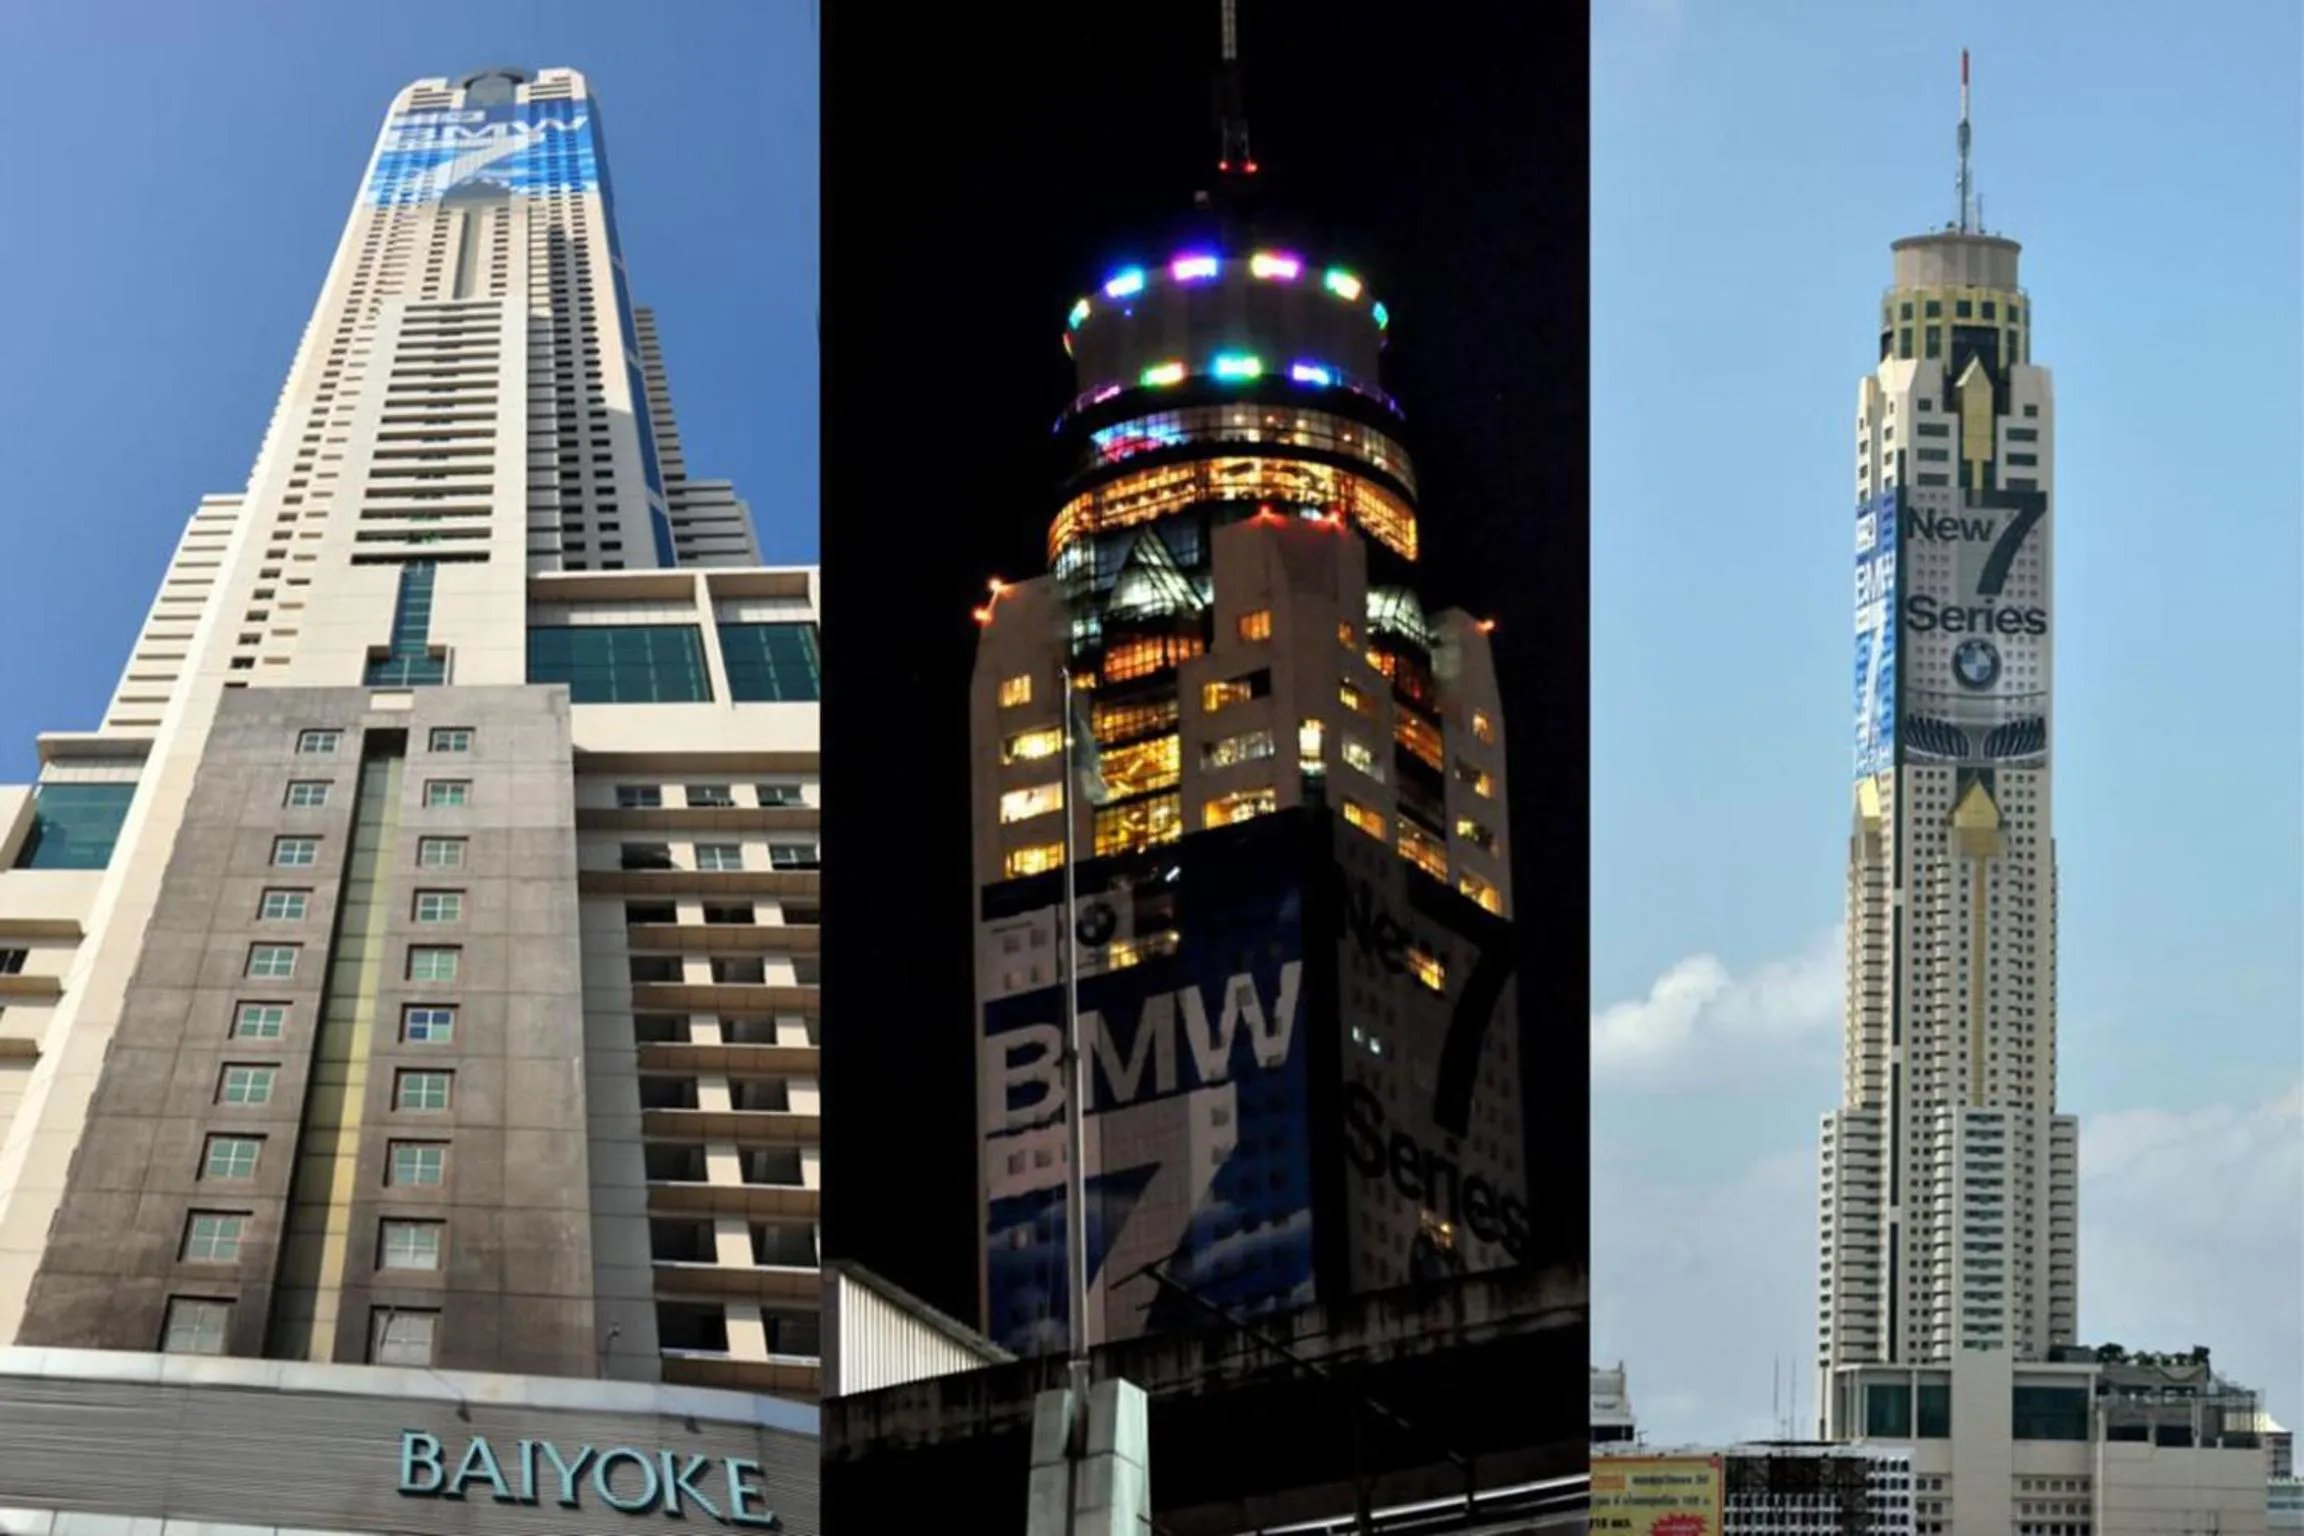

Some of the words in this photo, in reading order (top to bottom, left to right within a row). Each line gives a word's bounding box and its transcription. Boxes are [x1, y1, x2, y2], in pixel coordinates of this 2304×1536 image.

[384, 116, 588, 150] BMW
[1906, 506, 1996, 542] New
[1964, 490, 2047, 596] 7
[1906, 594, 2047, 636] Series
[986, 960, 1302, 1137] BMW
[1406, 864, 1519, 1138] 7
[985, 1082, 1238, 1346] 7
[1343, 1082, 1533, 1265] Series
[400, 1430, 779, 1526] BAIYOKE
